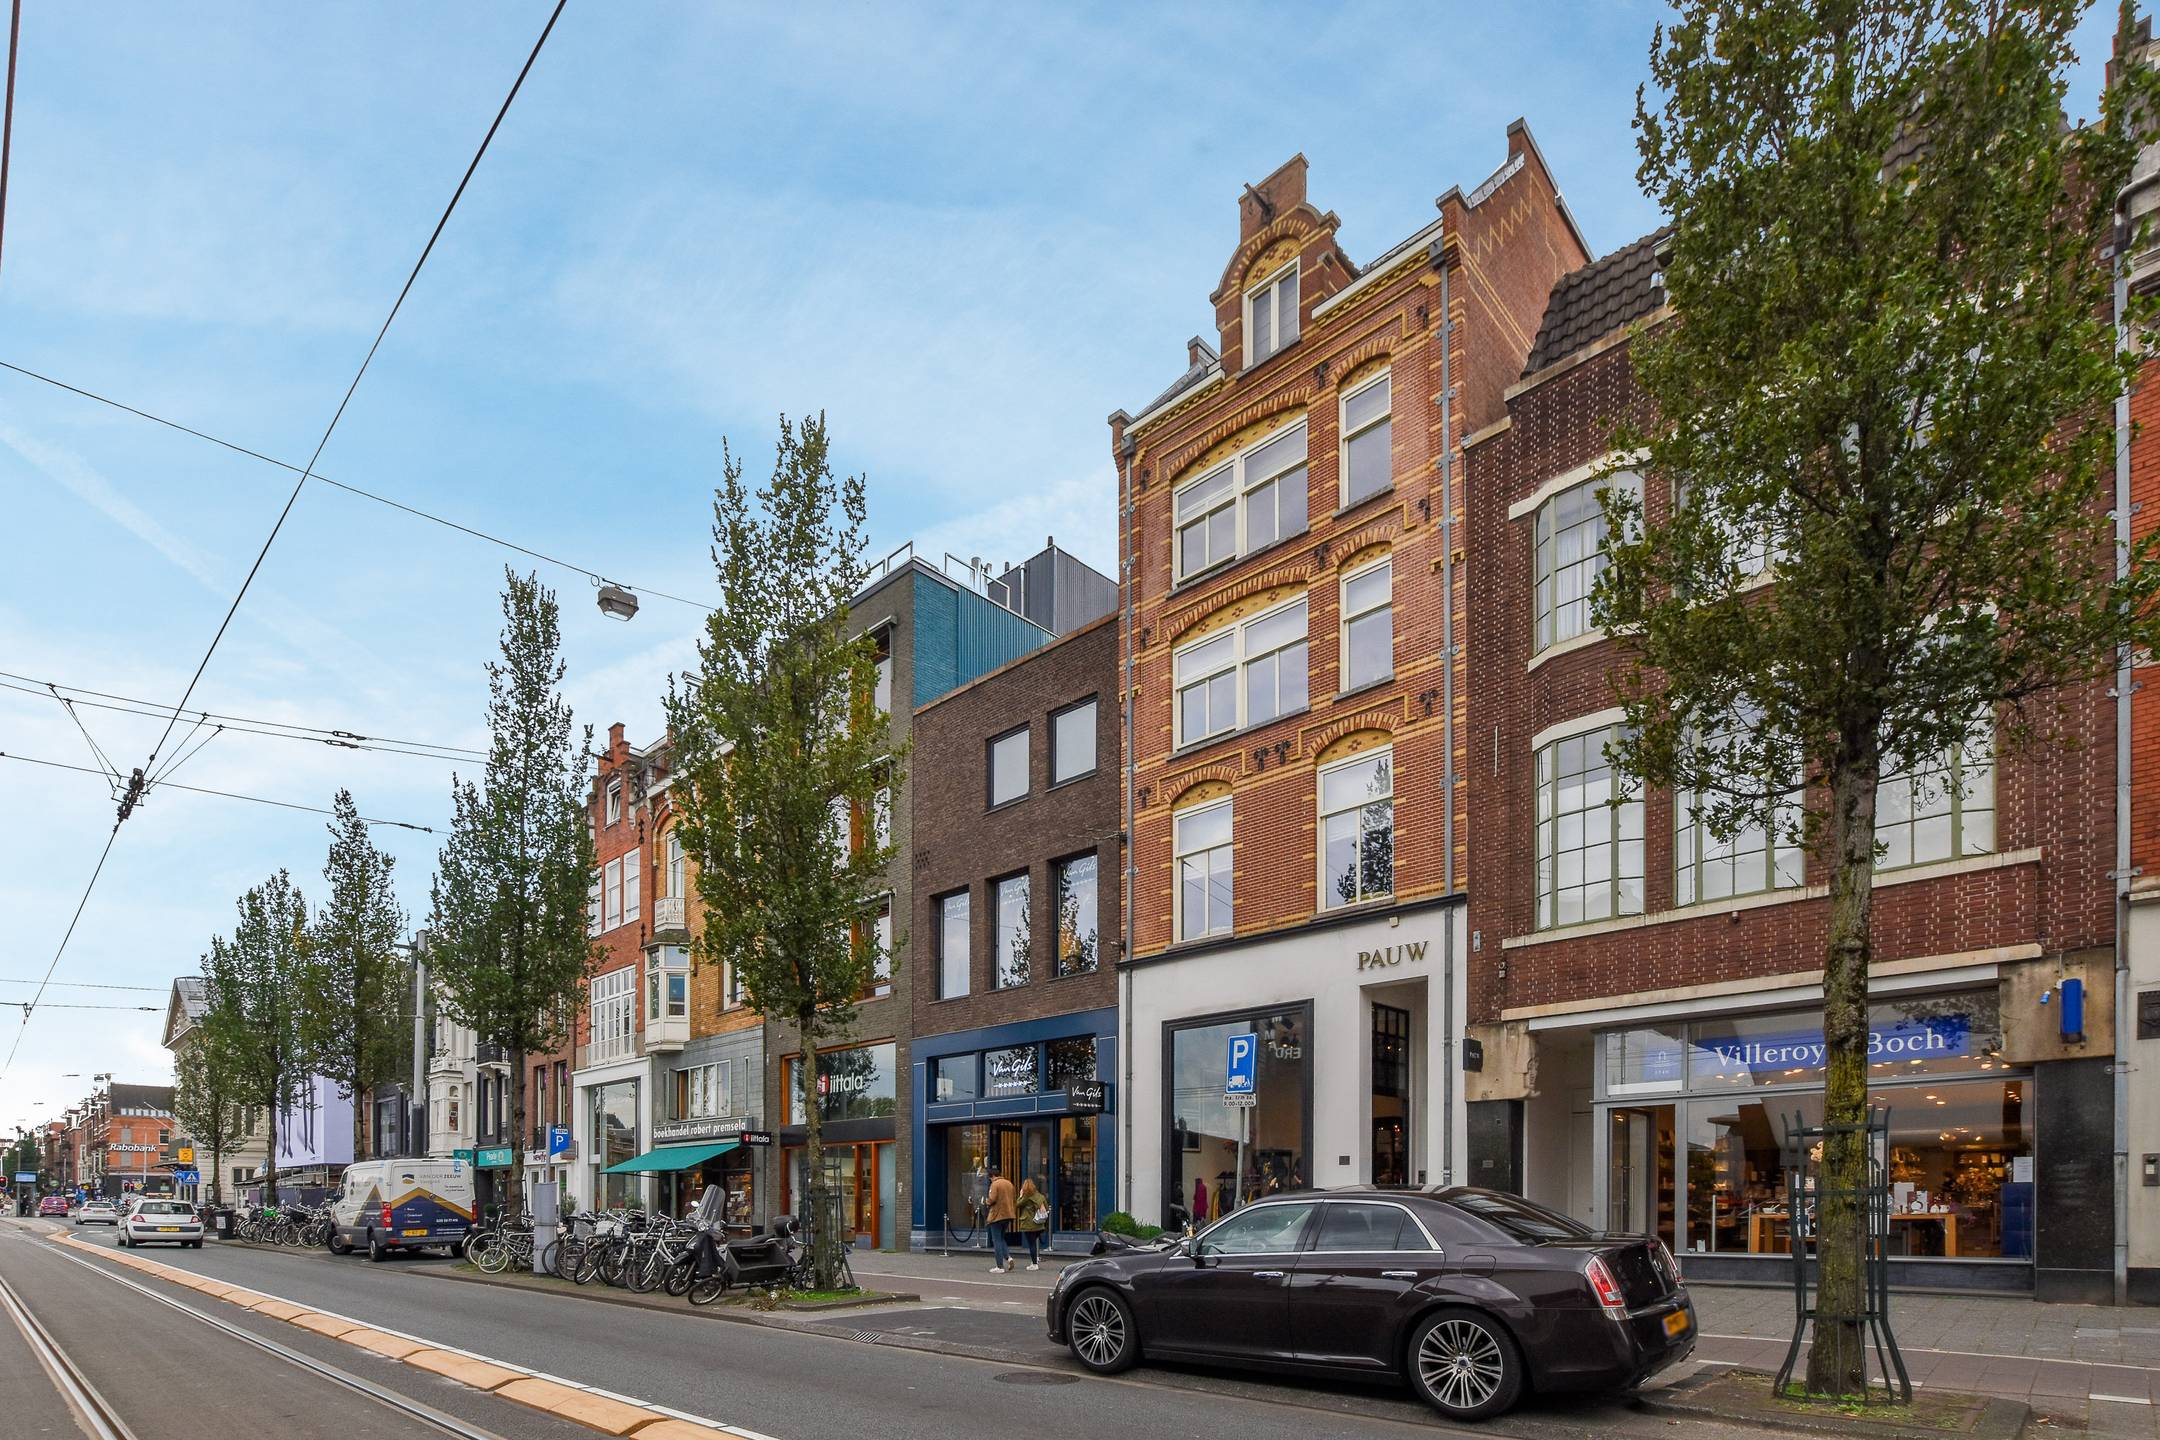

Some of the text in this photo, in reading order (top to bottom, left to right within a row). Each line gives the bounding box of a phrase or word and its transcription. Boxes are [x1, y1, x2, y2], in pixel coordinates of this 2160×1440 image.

[1357, 940, 1429, 970] PAUW
[1232, 1039, 1249, 1069] P
[1714, 1027, 1944, 1067] Villeroy Boch
[993, 1055, 1033, 1076] Van Gils
[830, 1072, 863, 1094] iittala
[1072, 1086, 1102, 1100] Van Gils
[653, 1118, 746, 1139] boekhandel robert premsela
[110, 1143, 157, 1152] Rabobank
[556, 1135, 564, 1147] P
